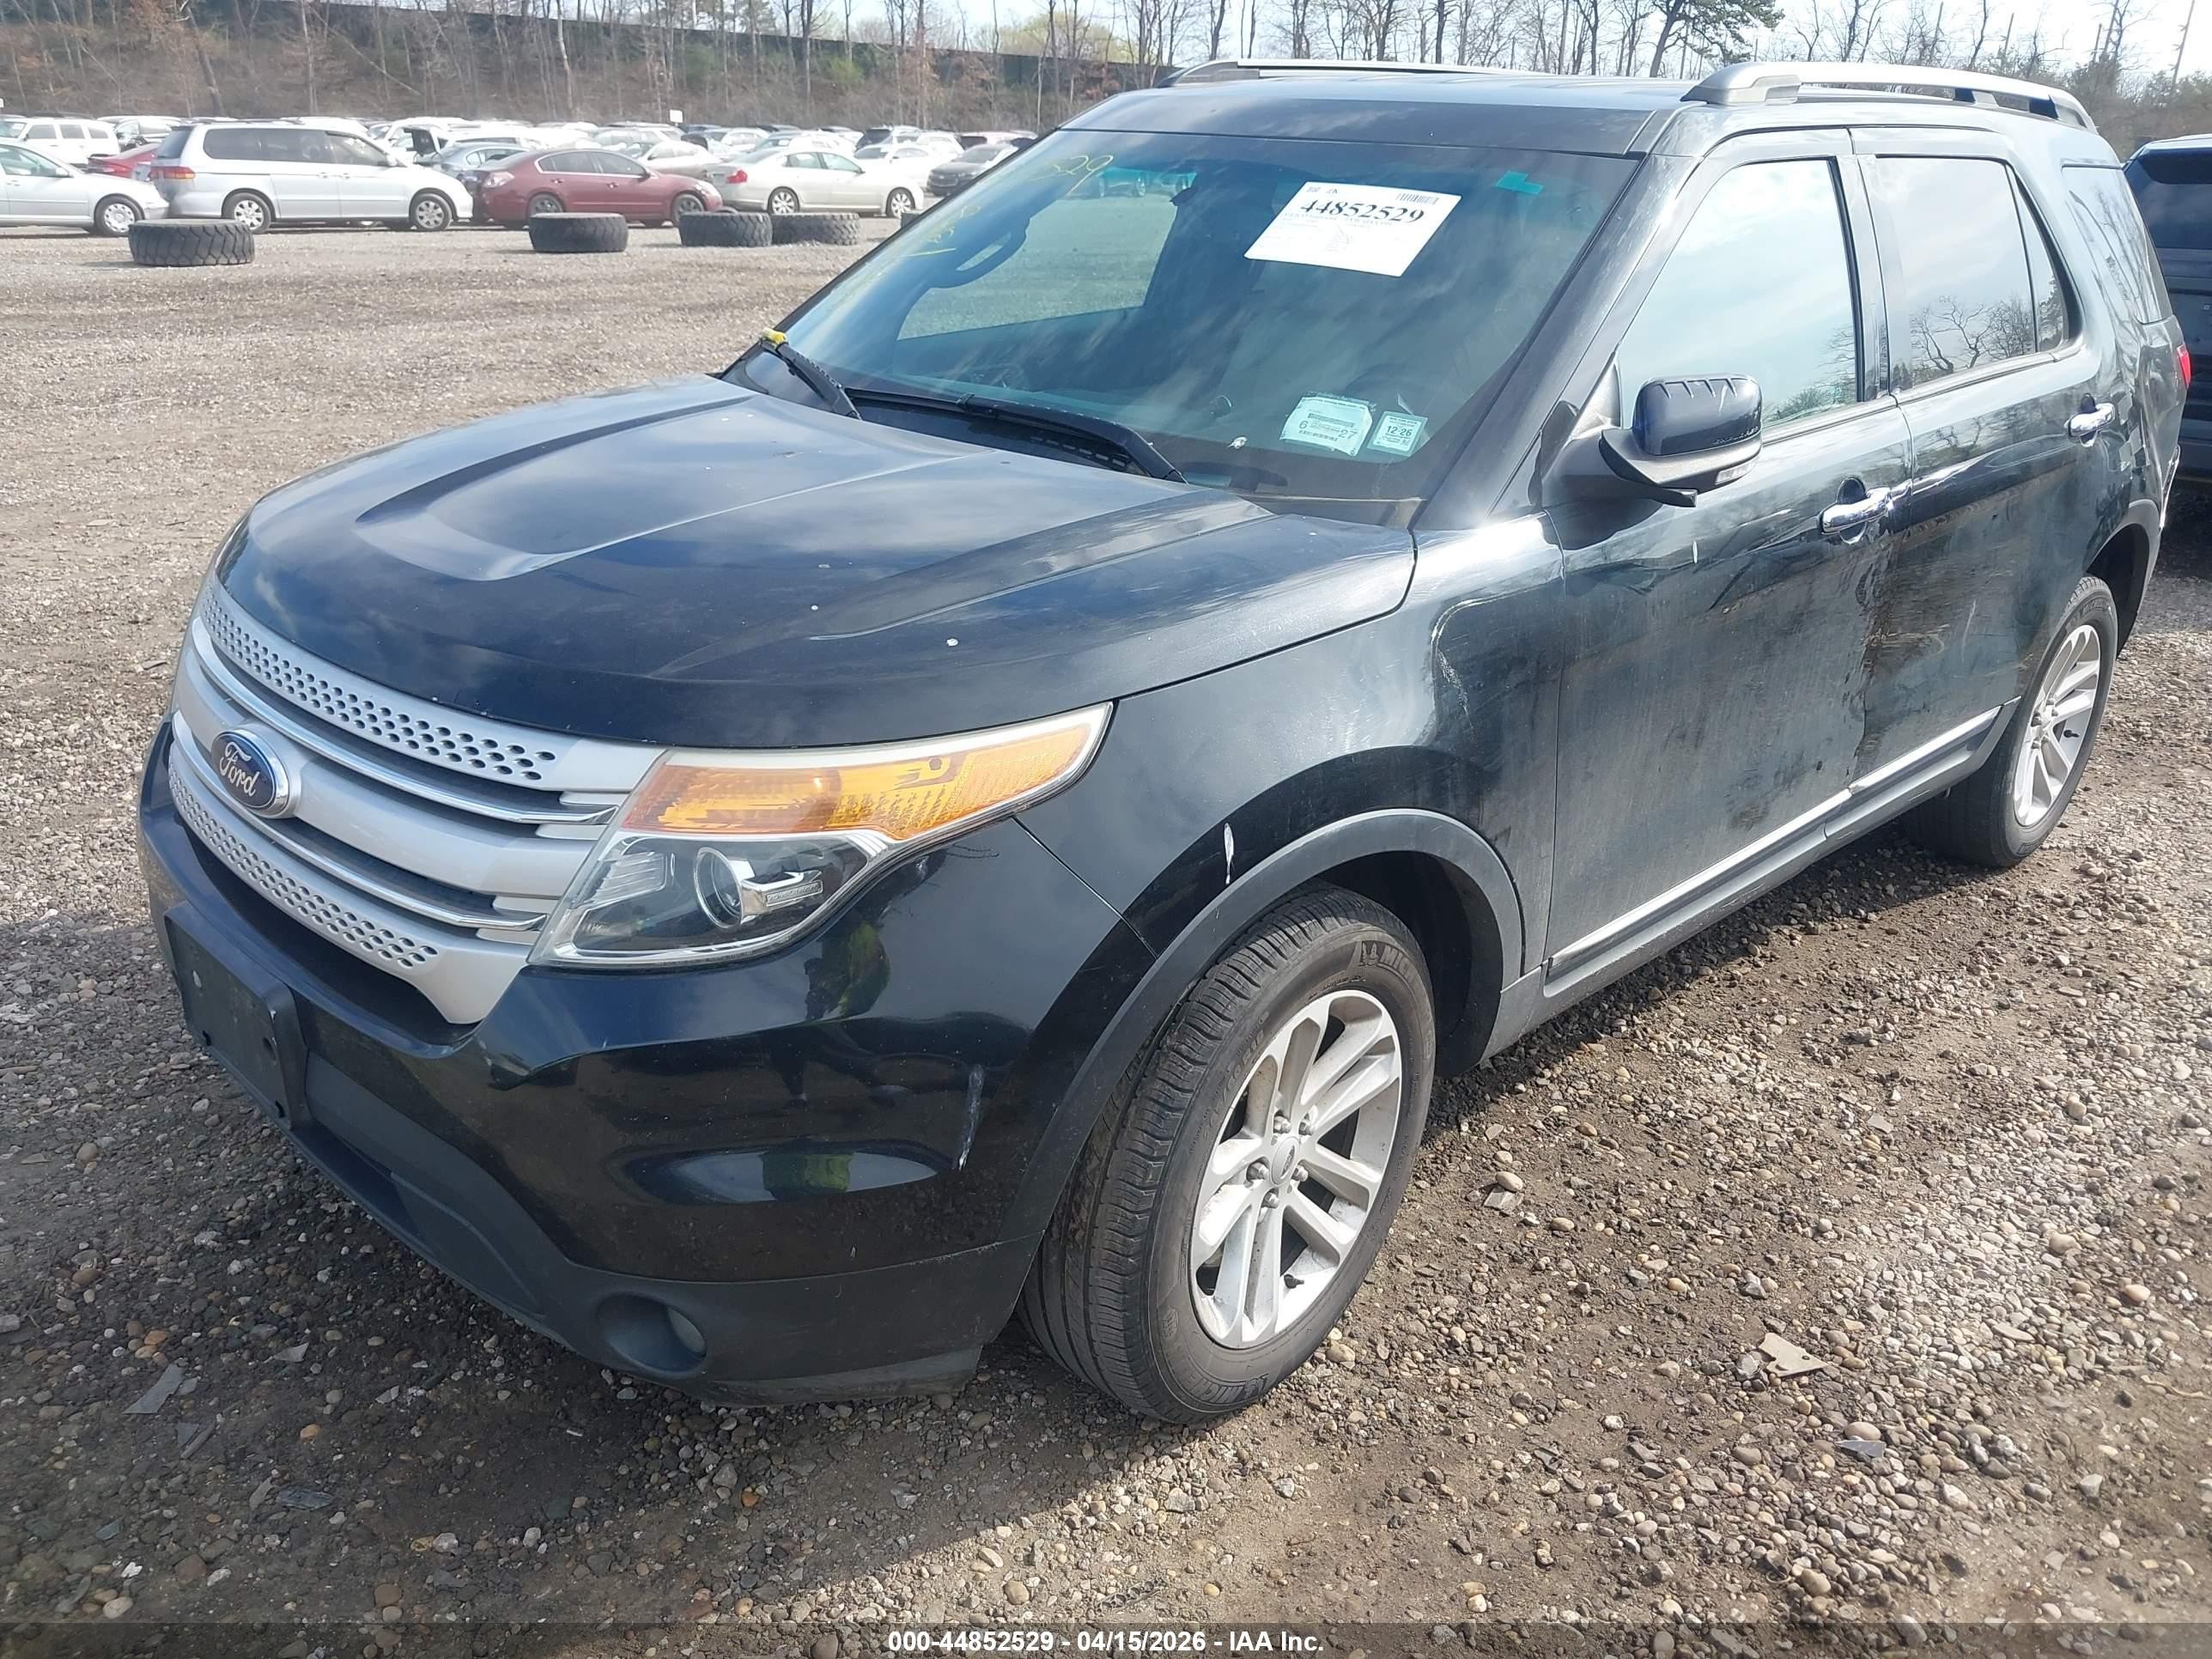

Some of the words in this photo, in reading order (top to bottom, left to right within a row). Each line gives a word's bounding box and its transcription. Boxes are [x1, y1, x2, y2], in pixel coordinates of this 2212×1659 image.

[1301, 198, 1425, 223] 44852529
[1338, 428, 1358, 440] 27
[219, 741, 260, 797] Ford
